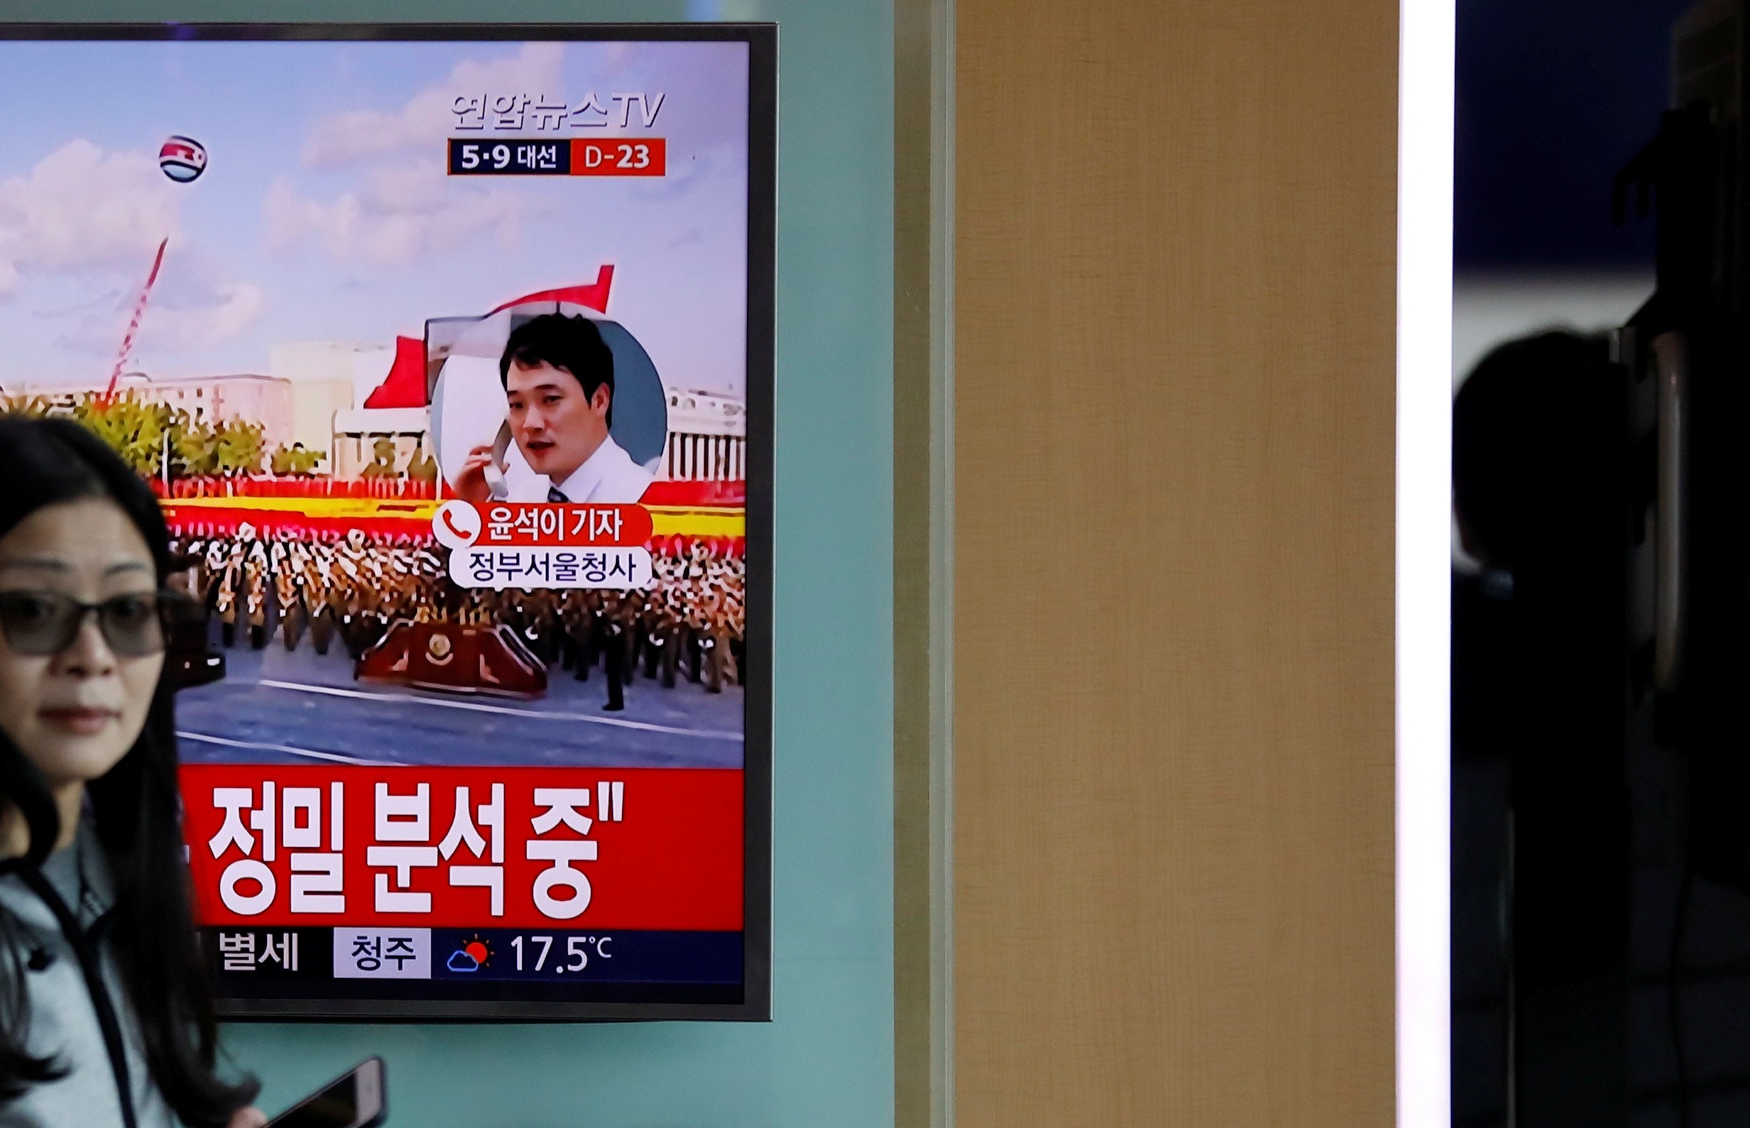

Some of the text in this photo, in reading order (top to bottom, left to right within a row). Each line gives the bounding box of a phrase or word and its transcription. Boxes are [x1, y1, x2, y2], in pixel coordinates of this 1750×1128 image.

[517, 145, 557, 169] 대선
[585, 145, 649, 169] D-23
[487, 507, 623, 541] 윤석이 기자
[468, 553, 637, 583] 정부서울청사
[208, 780, 345, 916] 정밀
[366, 781, 505, 917] 분석
[526, 781, 625, 920] 중"
[219, 932, 298, 971] 별세
[351, 935, 417, 972] 청주
